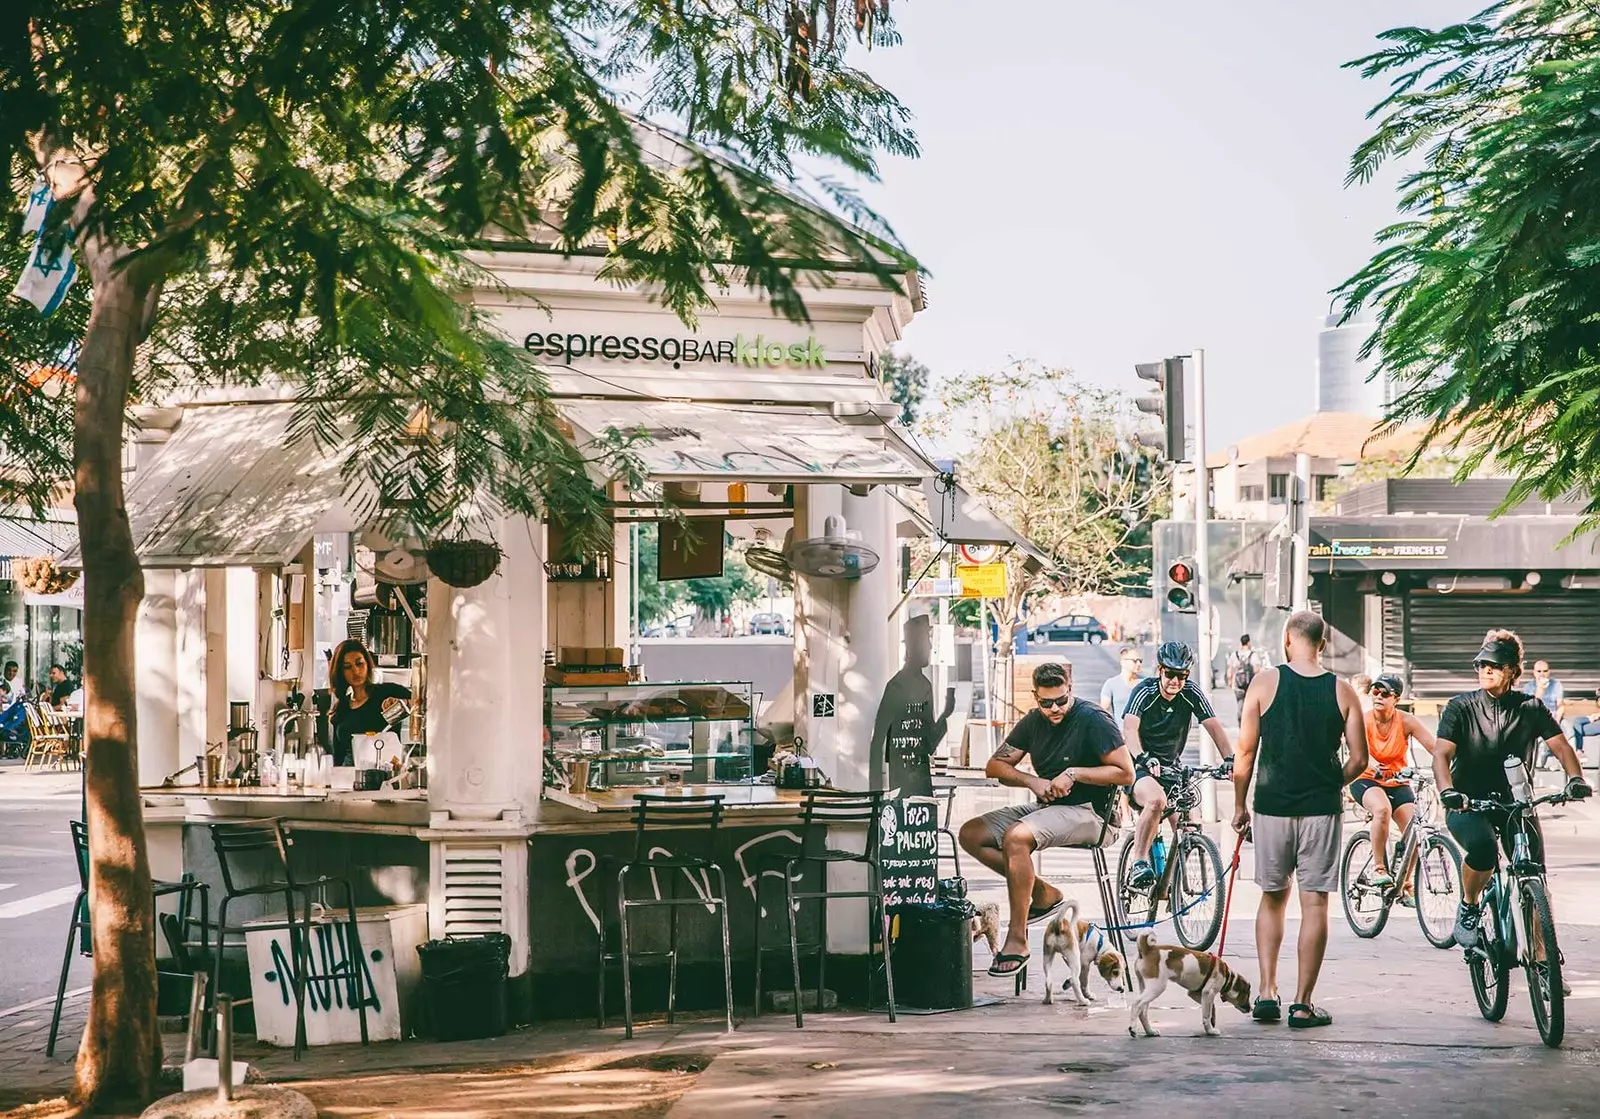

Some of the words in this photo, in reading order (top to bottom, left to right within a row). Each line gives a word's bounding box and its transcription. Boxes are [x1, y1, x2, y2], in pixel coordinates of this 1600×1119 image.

[524, 332, 681, 367] espresso
[1393, 546, 1434, 556] FRENCH
[1434, 546, 1447, 556] 57
[895, 830, 937, 855] PALETAS
